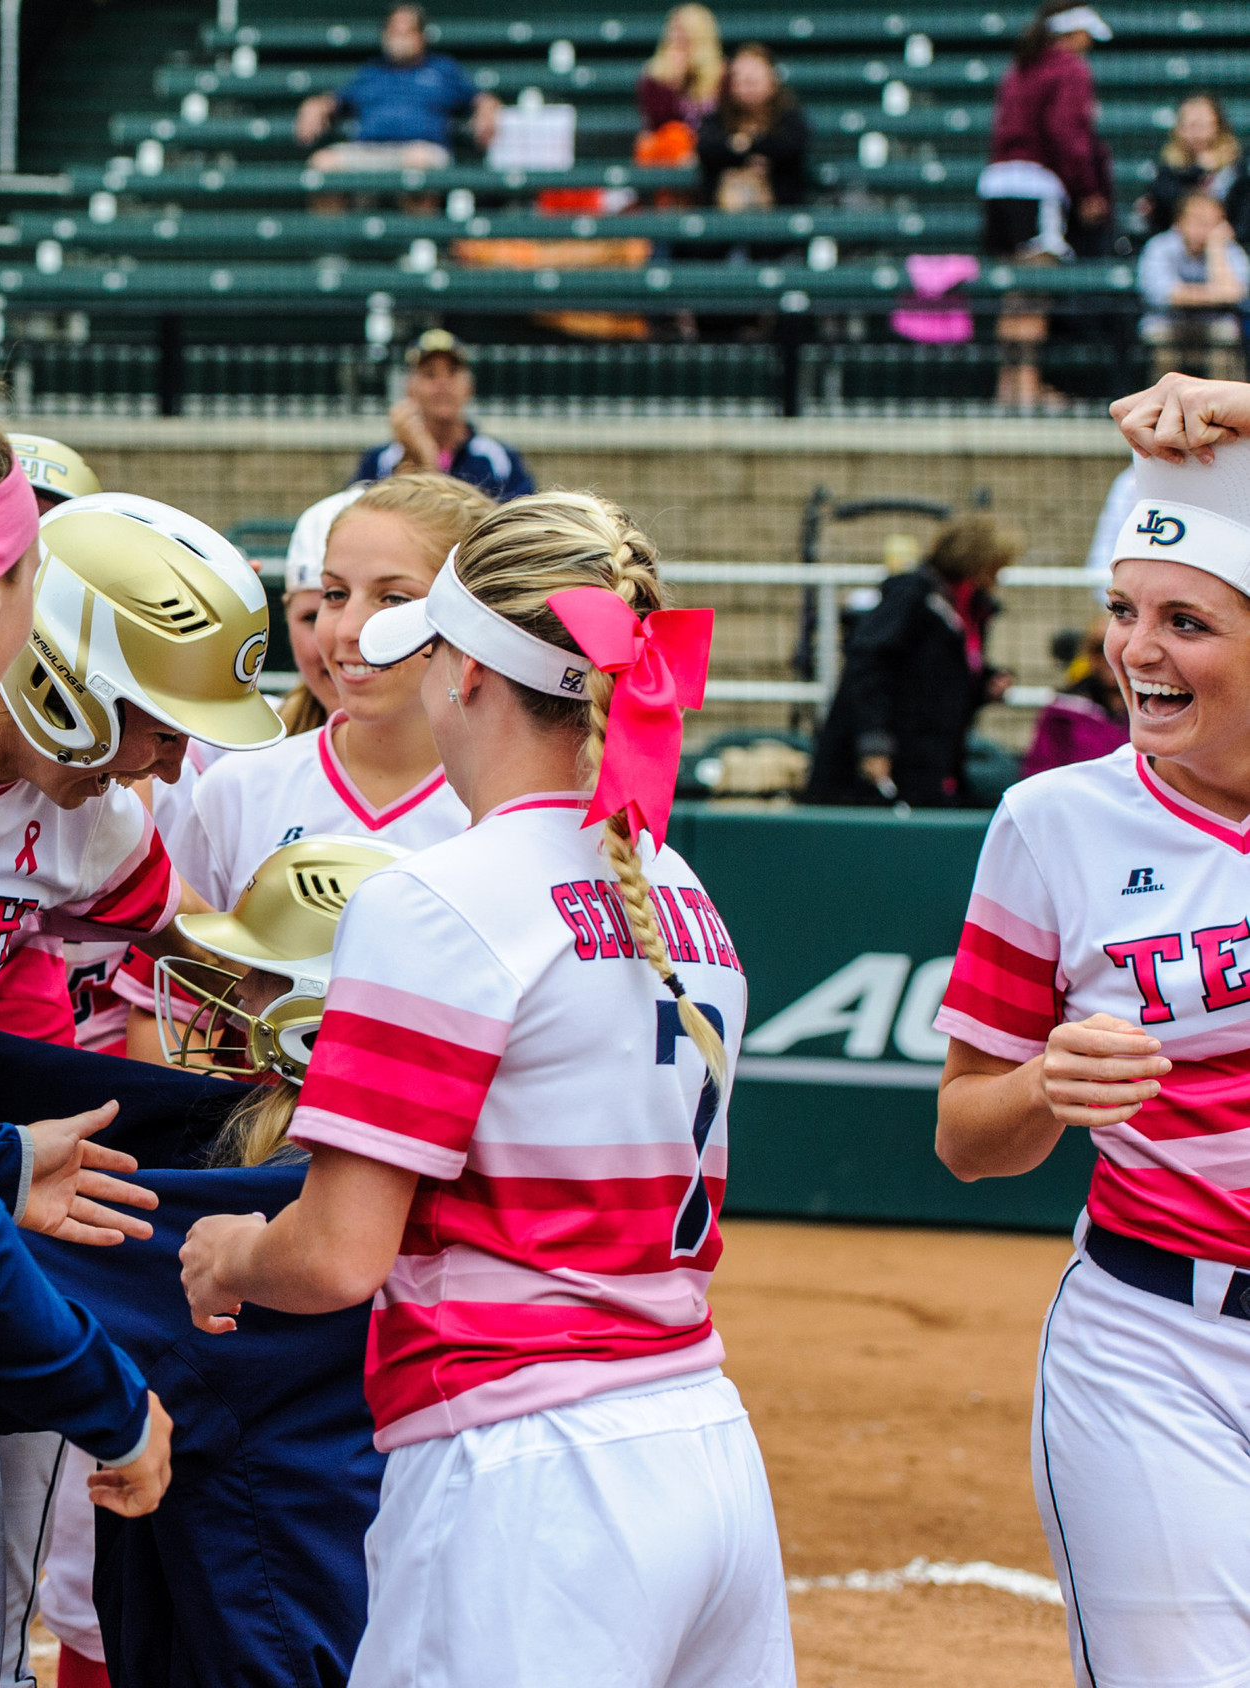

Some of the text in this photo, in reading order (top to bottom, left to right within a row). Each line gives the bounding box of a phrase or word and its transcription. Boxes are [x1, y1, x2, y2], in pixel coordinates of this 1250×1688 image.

[1136, 508, 1186, 546] GT
[31, 628, 86, 694] RAWLINGS
[1120, 882, 1166, 896] RUSSELL
[1127, 867, 1155, 888] R
[654, 999, 727, 1261] 7
